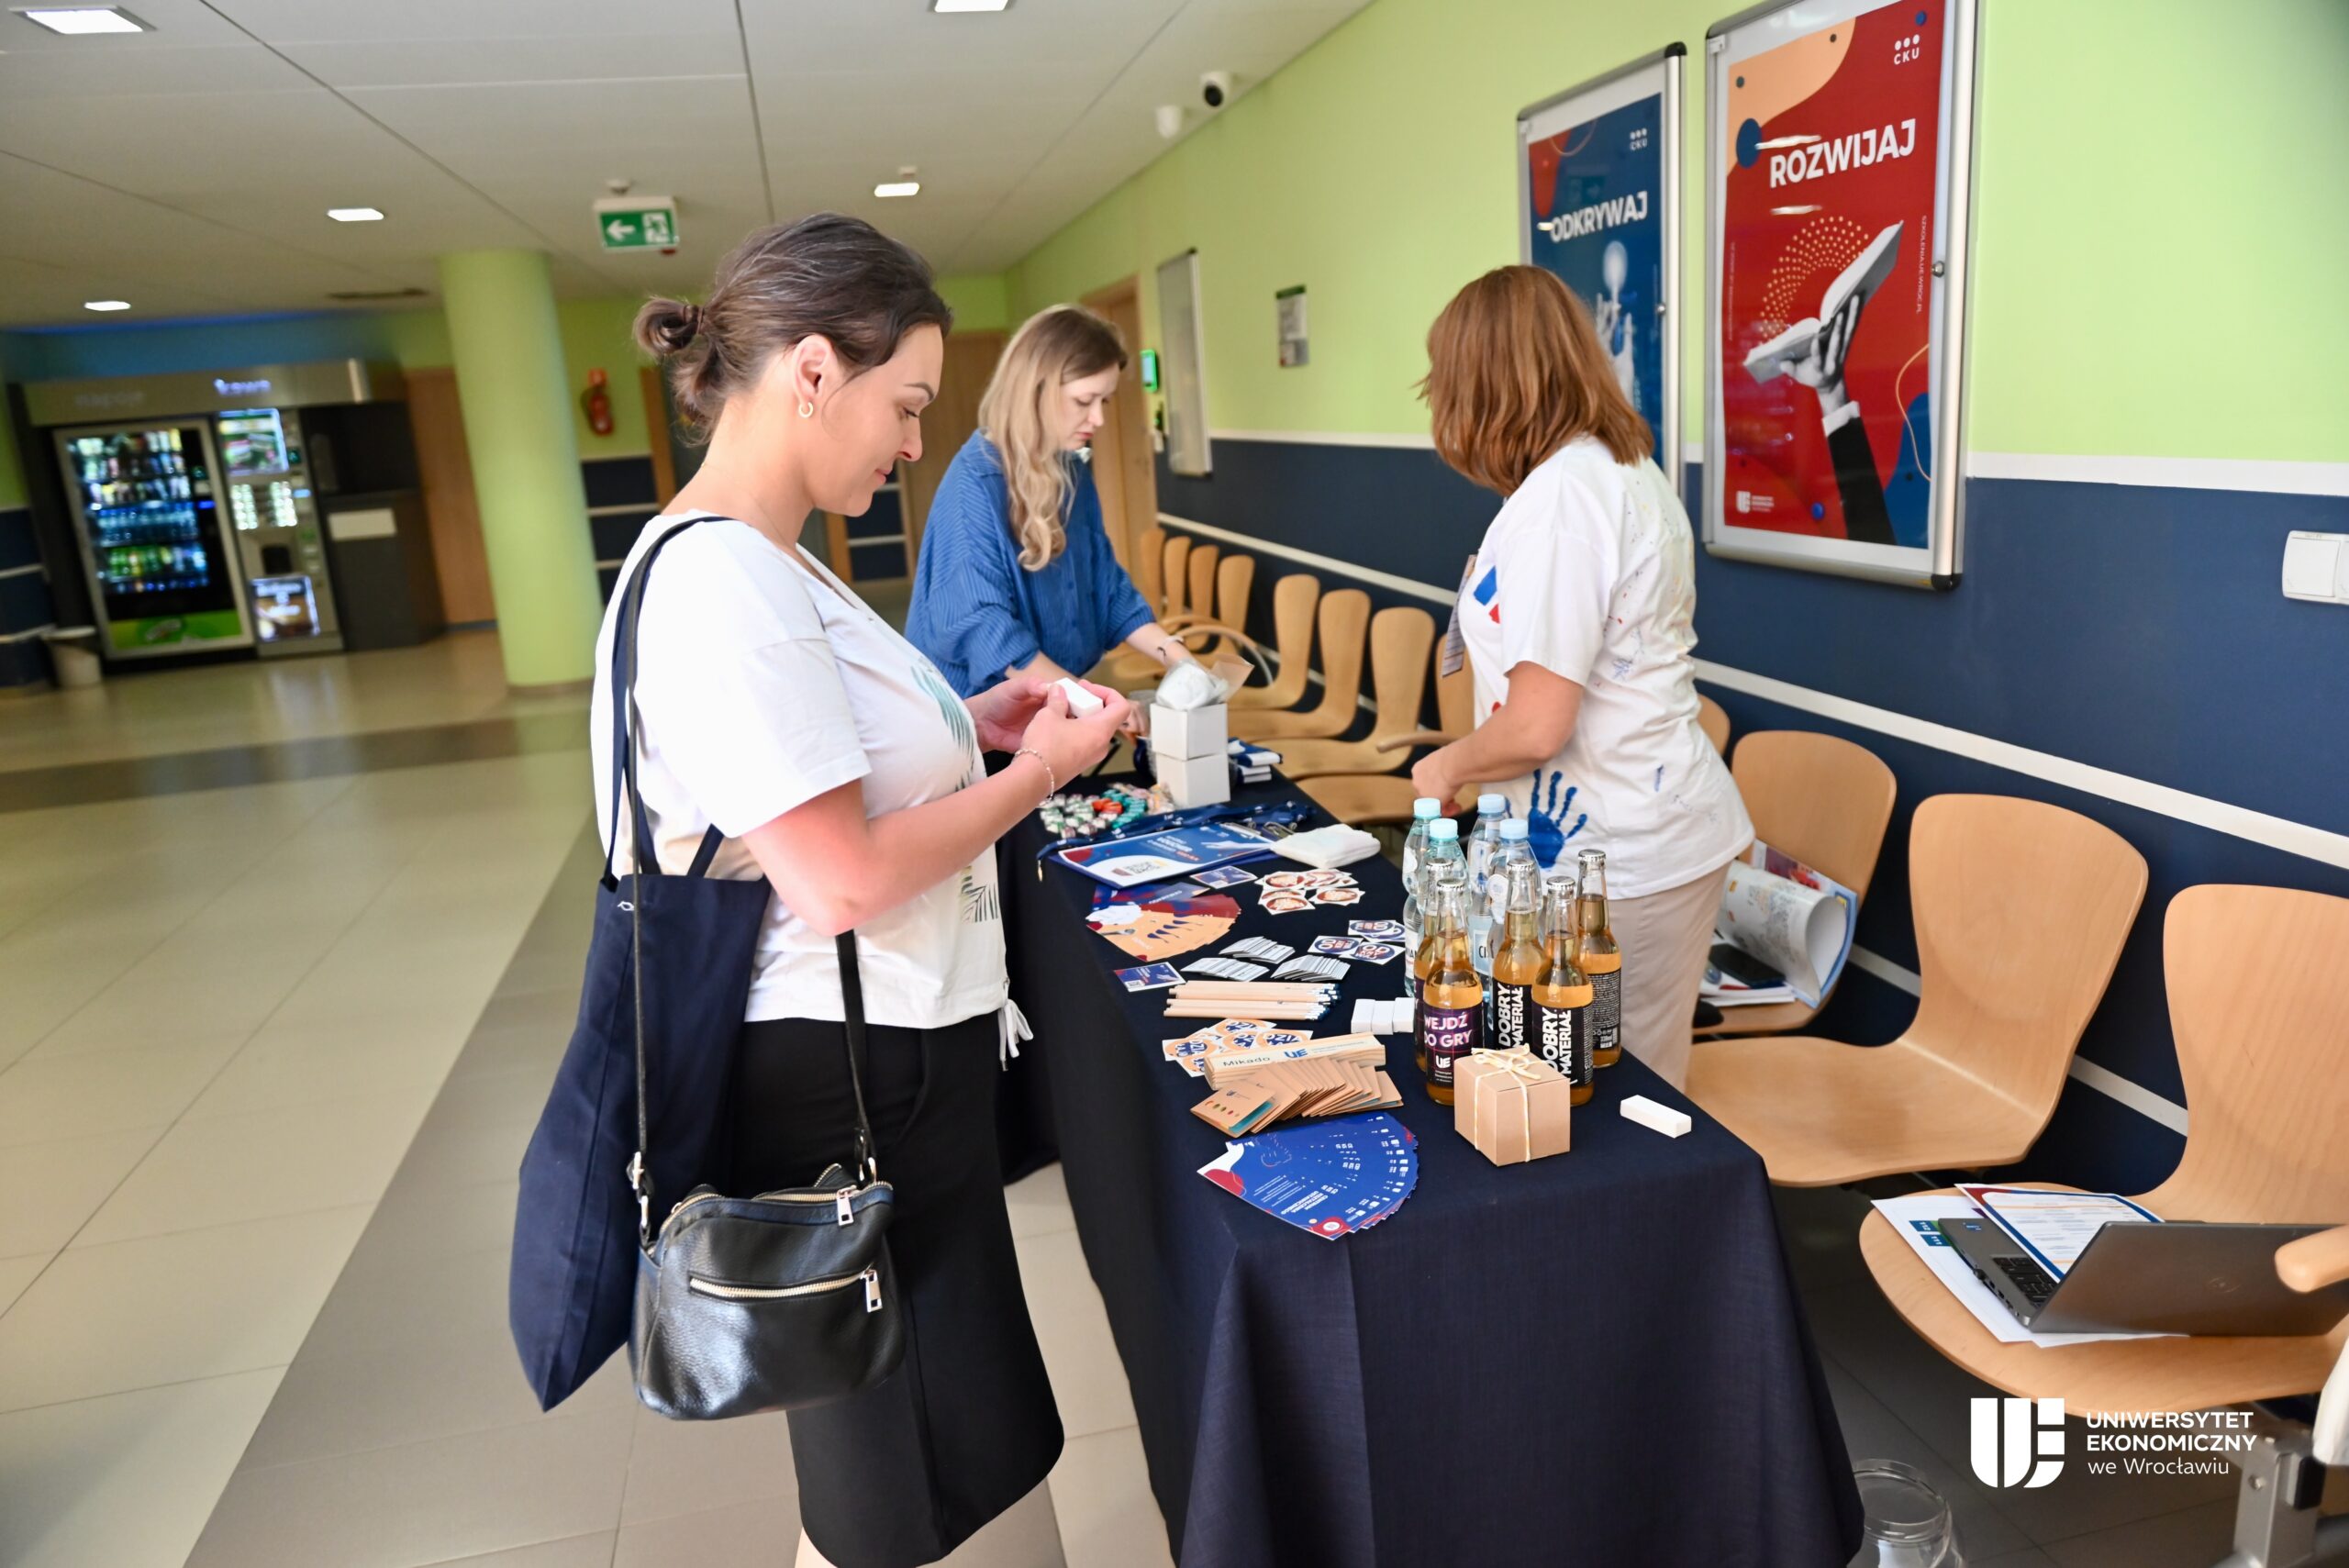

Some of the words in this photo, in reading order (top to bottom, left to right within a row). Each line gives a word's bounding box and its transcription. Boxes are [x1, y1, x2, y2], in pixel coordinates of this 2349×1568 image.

[1893, 46, 1920, 65] CKU
[1769, 118, 1917, 189] ROZWIJAJ
[1550, 190, 1648, 243] ODKRYWAJ
[1424, 1011, 1468, 1030] WEJDŹ
[1497, 983, 1512, 1047] DOBRY
[1440, 1029, 1473, 1048] GRY
[1558, 1009, 1572, 1074] MATERIAŁ
[1222, 1056, 1271, 1067] Mikado
[1284, 1049, 1308, 1059] UE
